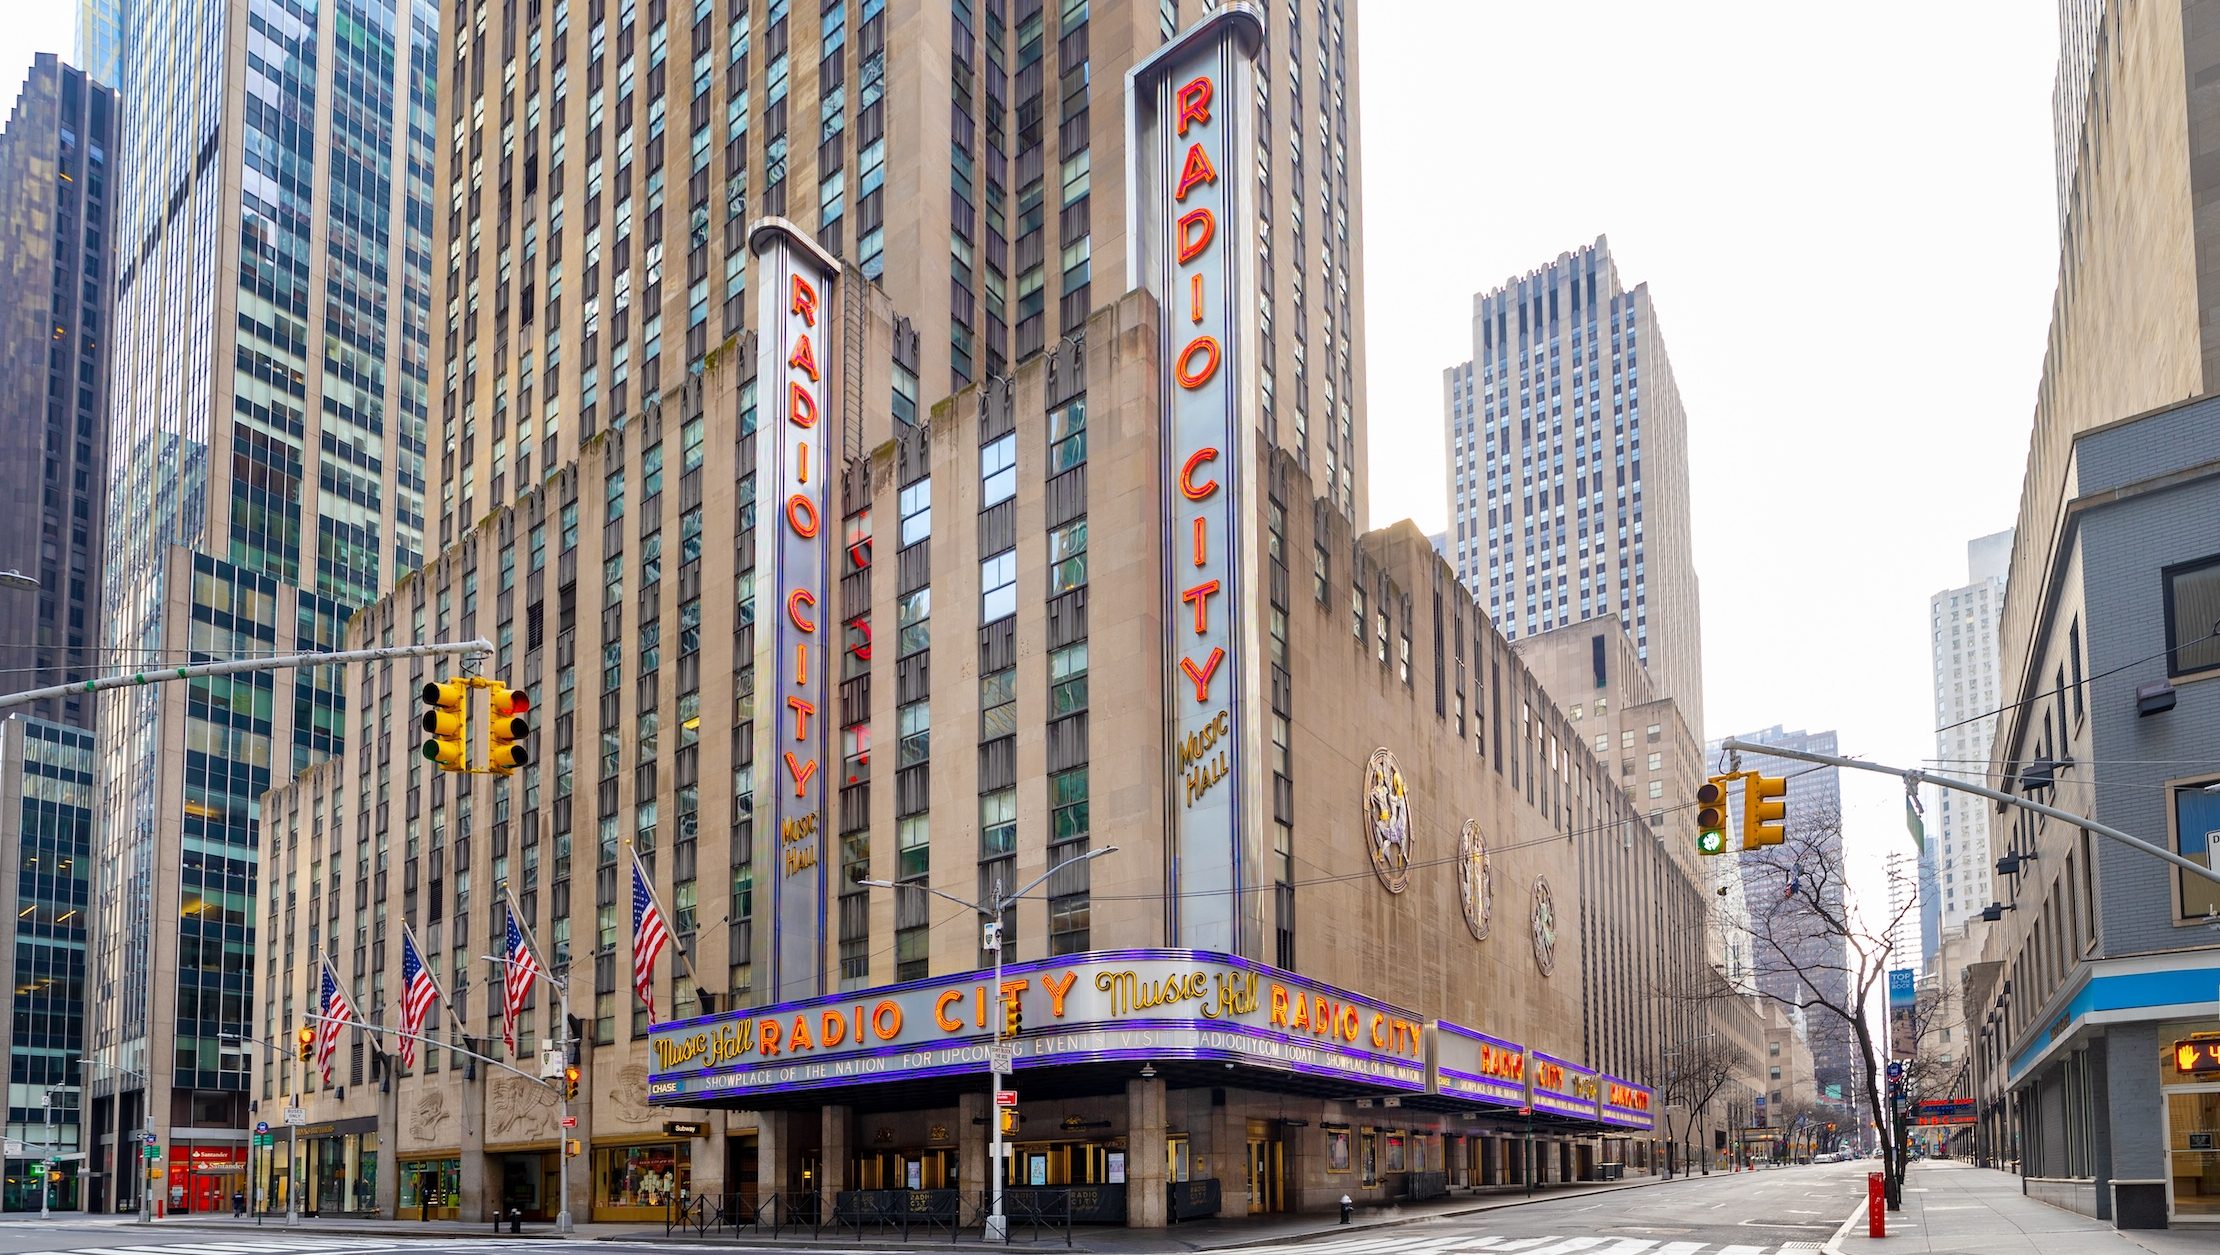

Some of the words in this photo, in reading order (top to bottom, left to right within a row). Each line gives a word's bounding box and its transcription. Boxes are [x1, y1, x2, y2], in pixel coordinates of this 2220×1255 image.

[1176, 76, 1221, 389] RADIO
[786, 272, 820, 538] RADIO
[1179, 447, 1225, 702] CITY
[784, 587, 818, 798] CITY
[1177, 710, 1228, 777] MUSIC
[1186, 751, 1229, 808] HALL
[782, 812, 818, 847] MUSIC
[785, 845, 818, 879] HALL
[759, 1000, 903, 1056] RADIO
[935, 970, 1078, 1032] CITY
[1095, 970, 1208, 1016] Music
[1201, 971, 1260, 1019] Hall
[1271, 983, 1359, 1042] RADIO
[1371, 1012, 1422, 1056] CITY
[653, 1034, 707, 1071] Music
[702, 1018, 754, 1067] Hall
[705, 1069, 772, 1090] SHOWPLACE
[780, 1067, 796, 1081] OF
[805, 1062, 826, 1078] THE
[835, 1057, 886, 1075] NATION
[903, 1053, 932, 1068] FOR
[941, 1041, 1023, 1064] UPCOMG
[1035, 1033, 1104, 1054] EVENTS
[1284, 1044, 1316, 1062] TODAY!
[1326, 1053, 1368, 1074] SHOWPLACE
[1371, 1062, 1381, 1075] OF
[1384, 1063, 1396, 1078] THE
[1398, 1067, 1420, 1082] NATION
[1481, 1043, 1524, 1079] RADIO
[652, 1082, 677, 1094] CHASE
[1538, 1060, 1564, 1089] CITY
[675, 1125, 696, 1133] Subway
[208, 1162, 244, 1170] Santander
